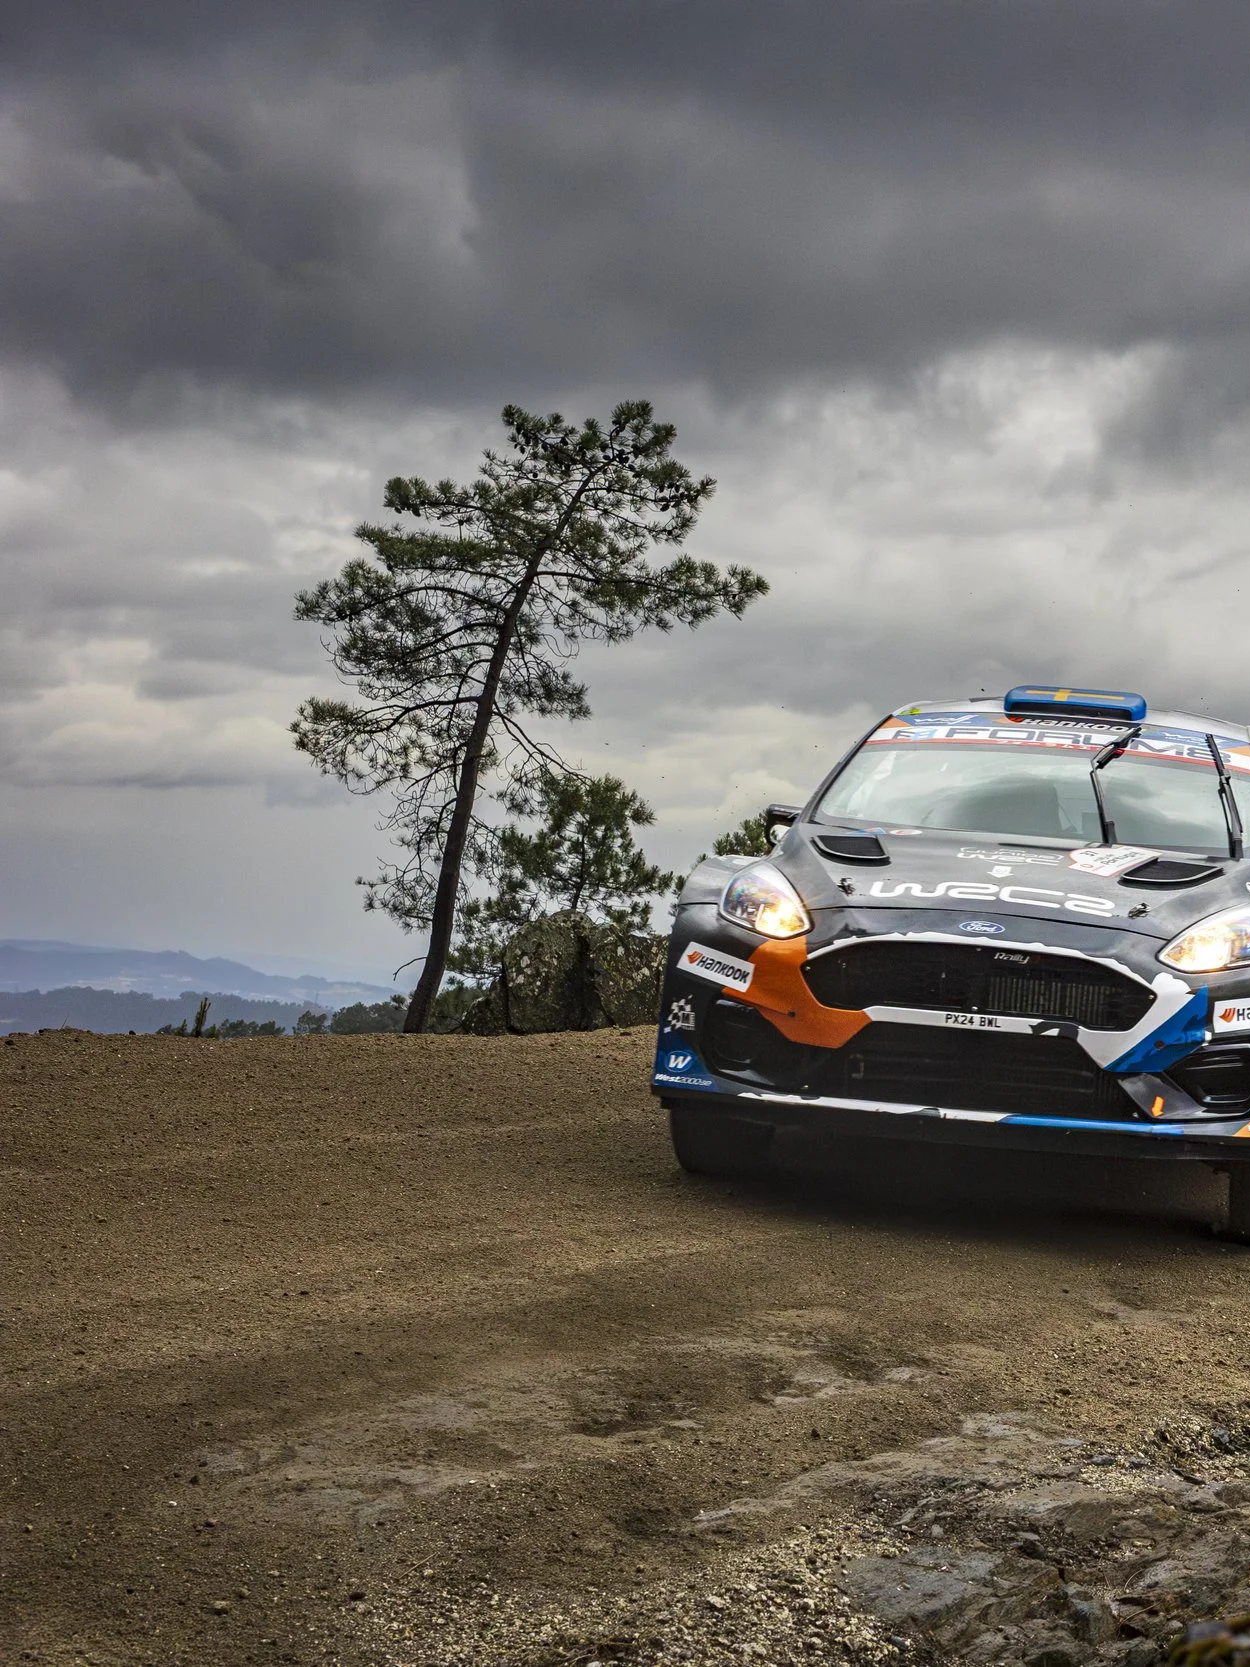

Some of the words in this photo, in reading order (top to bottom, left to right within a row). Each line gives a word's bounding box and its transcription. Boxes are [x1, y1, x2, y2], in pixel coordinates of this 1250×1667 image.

[869, 881, 1115, 917] WRC2
[945, 1014, 975, 1025] PX24
[668, 1054, 692, 1069] W
